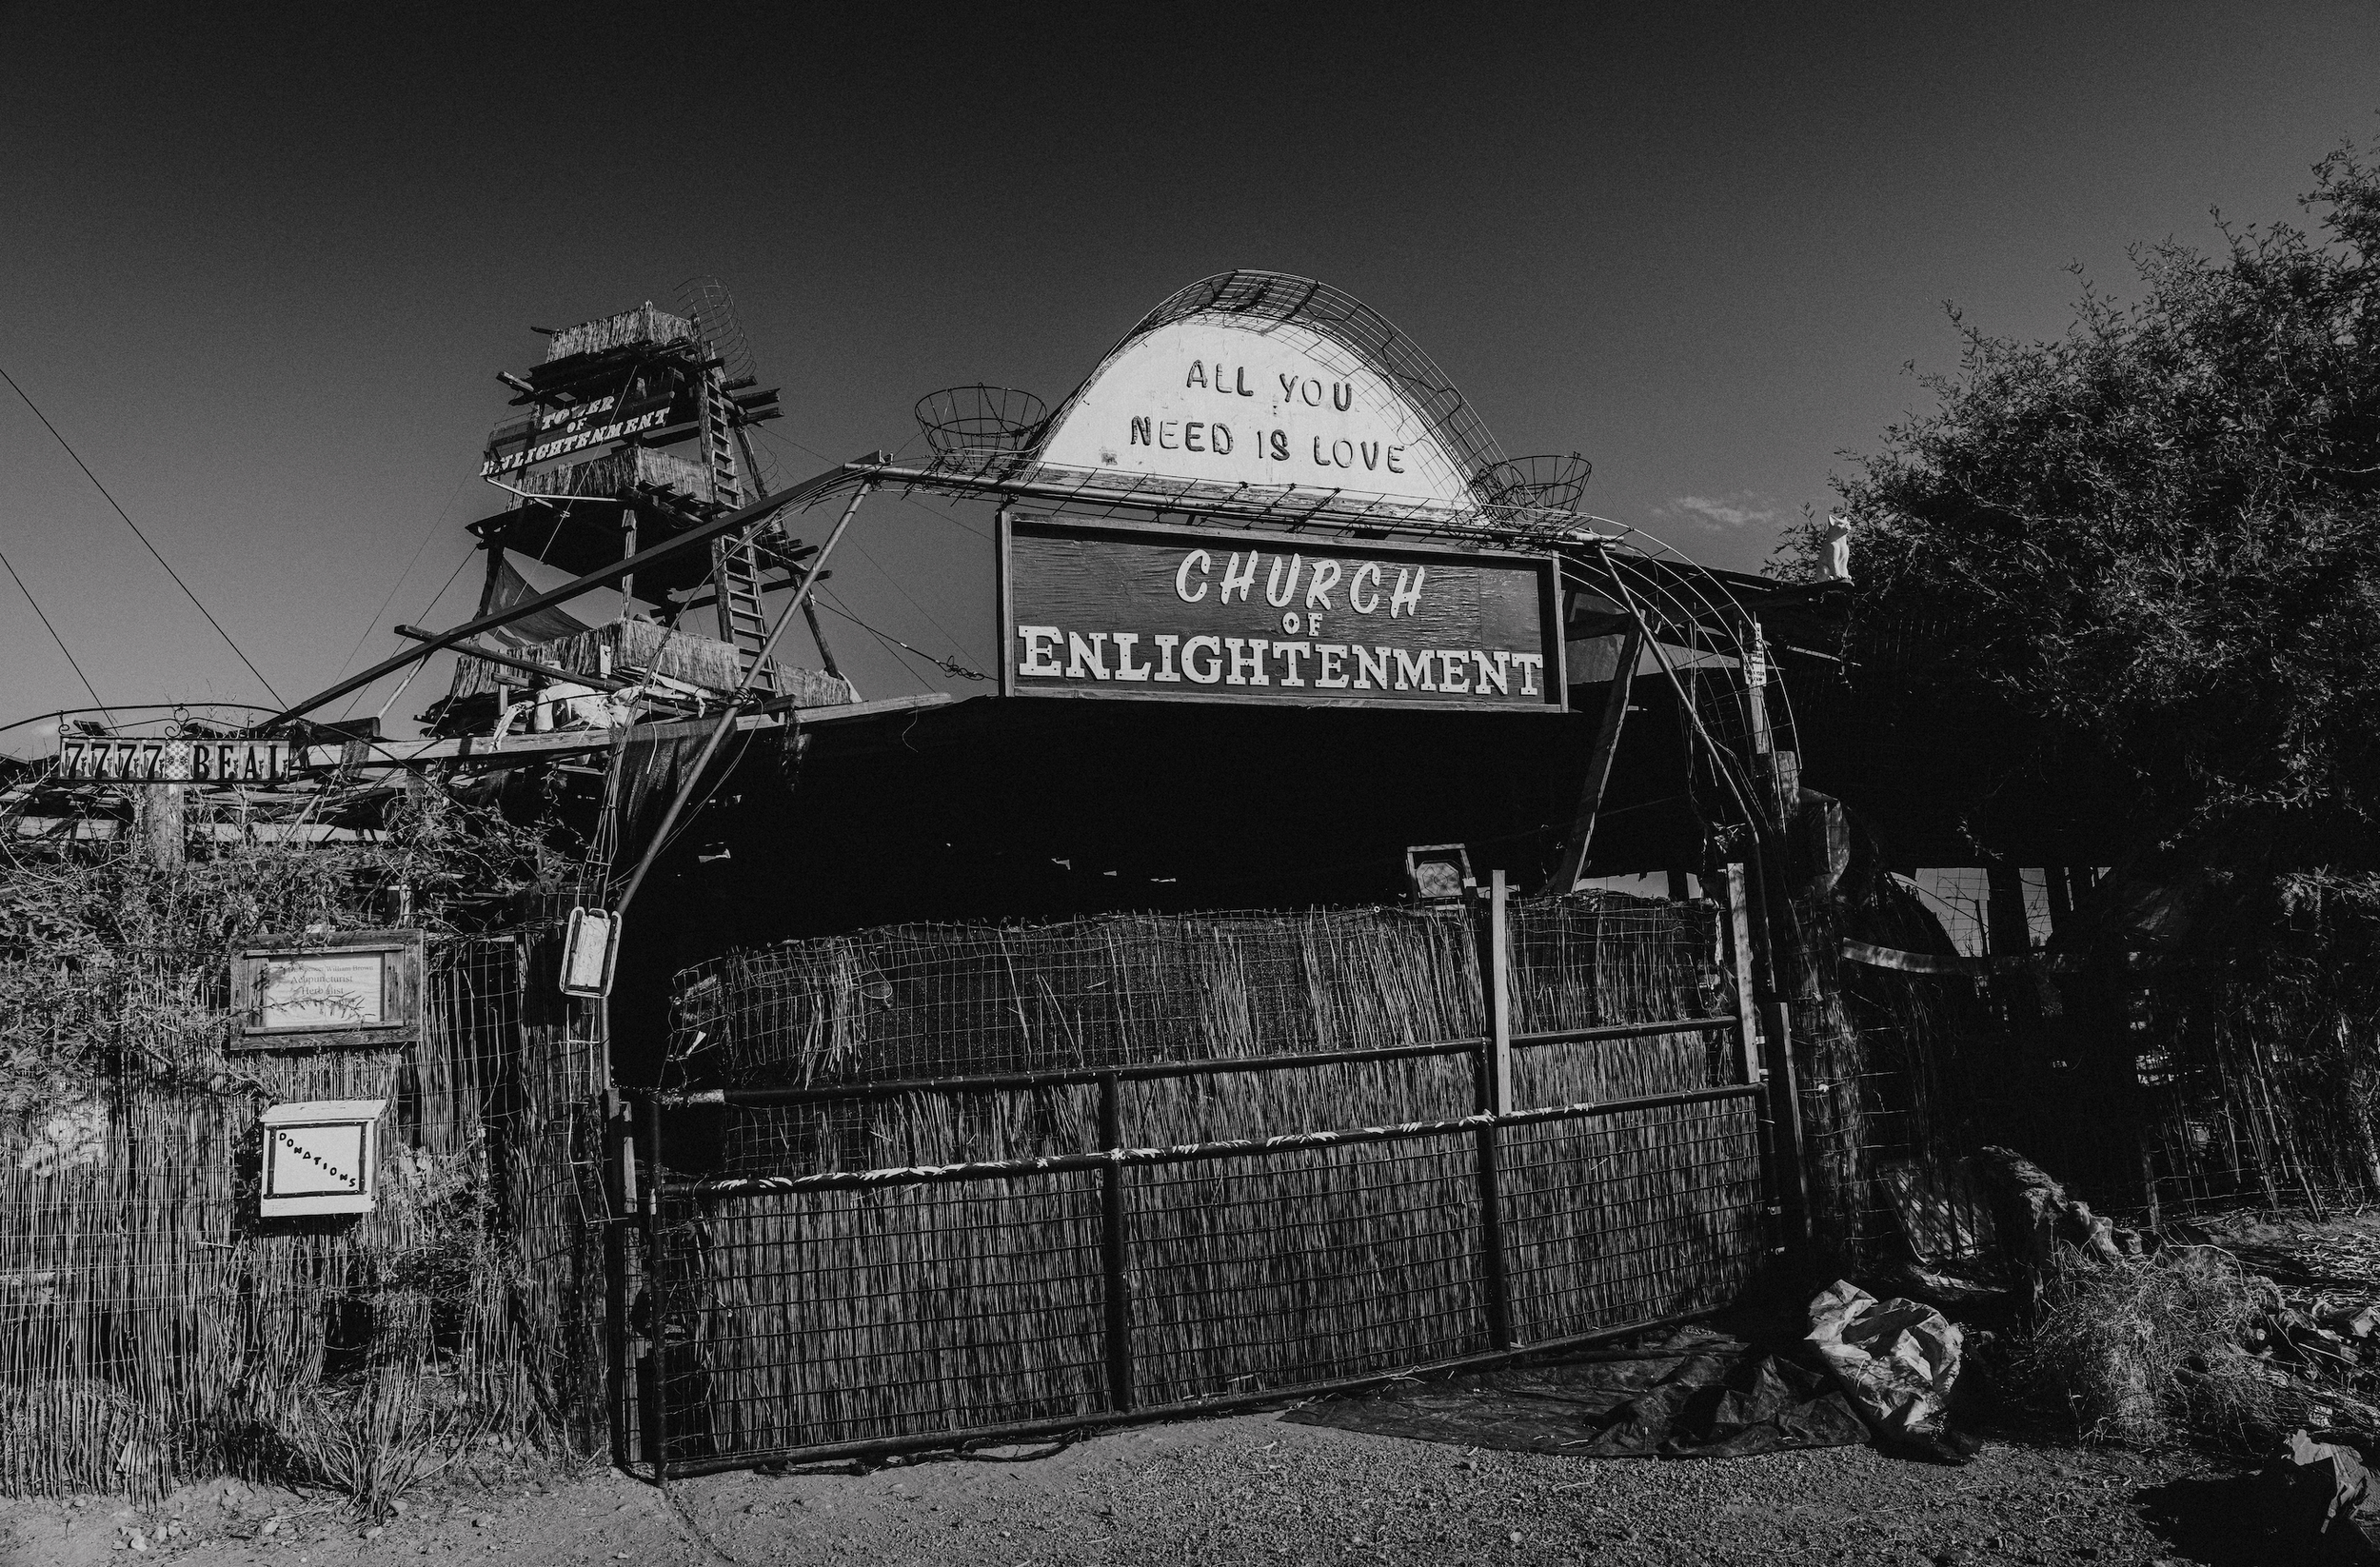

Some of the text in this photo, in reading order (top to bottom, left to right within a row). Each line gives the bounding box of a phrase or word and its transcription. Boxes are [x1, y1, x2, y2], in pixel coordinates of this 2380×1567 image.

[1186, 359, 1353, 411] ALL YOU
[566, 417, 588, 433] OF
[1130, 415, 1406, 473] NEED IS LOVE
[1175, 549, 1426, 619] CHURCH
[1281, 611, 1323, 637] OF
[1018, 625, 1544, 696] ENLIGHTENMENT
[65, 744, 287, 779] 7777 BEAL
[290, 975, 353, 985] Acupuncturist
[279, 1132, 356, 1187] DONATIONS
